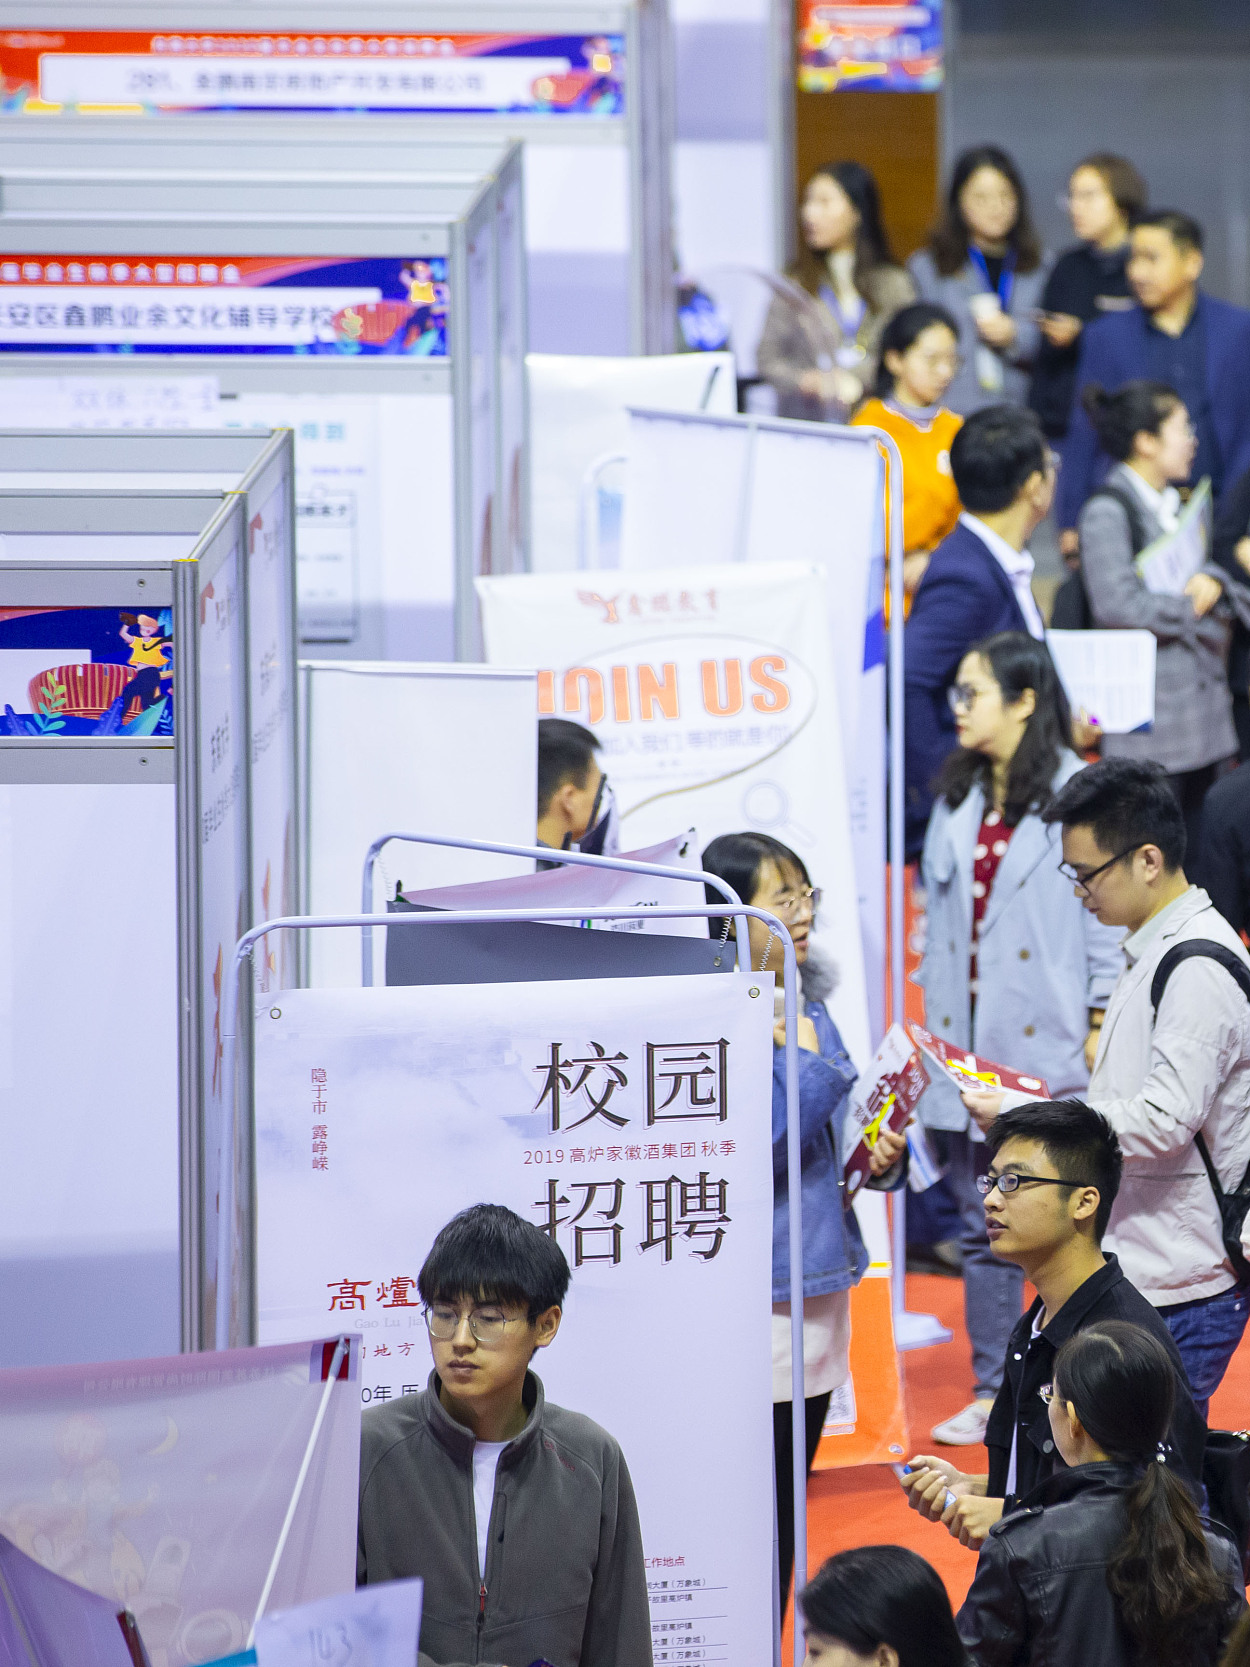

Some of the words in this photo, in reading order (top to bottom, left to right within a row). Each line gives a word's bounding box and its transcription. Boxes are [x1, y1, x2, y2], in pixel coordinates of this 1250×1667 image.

[701, 656, 791, 717] US
[530, 1037, 731, 1135] 校园
[523, 1149, 564, 1165] 2019
[569, 1142, 696, 1164] 高炉家徽酒集团
[701, 1139, 737, 1158] 秋季
[530, 1171, 732, 1271] 招聘
[354, 1318, 379, 1329] Gao
[385, 1317, 400, 1328] Lu
